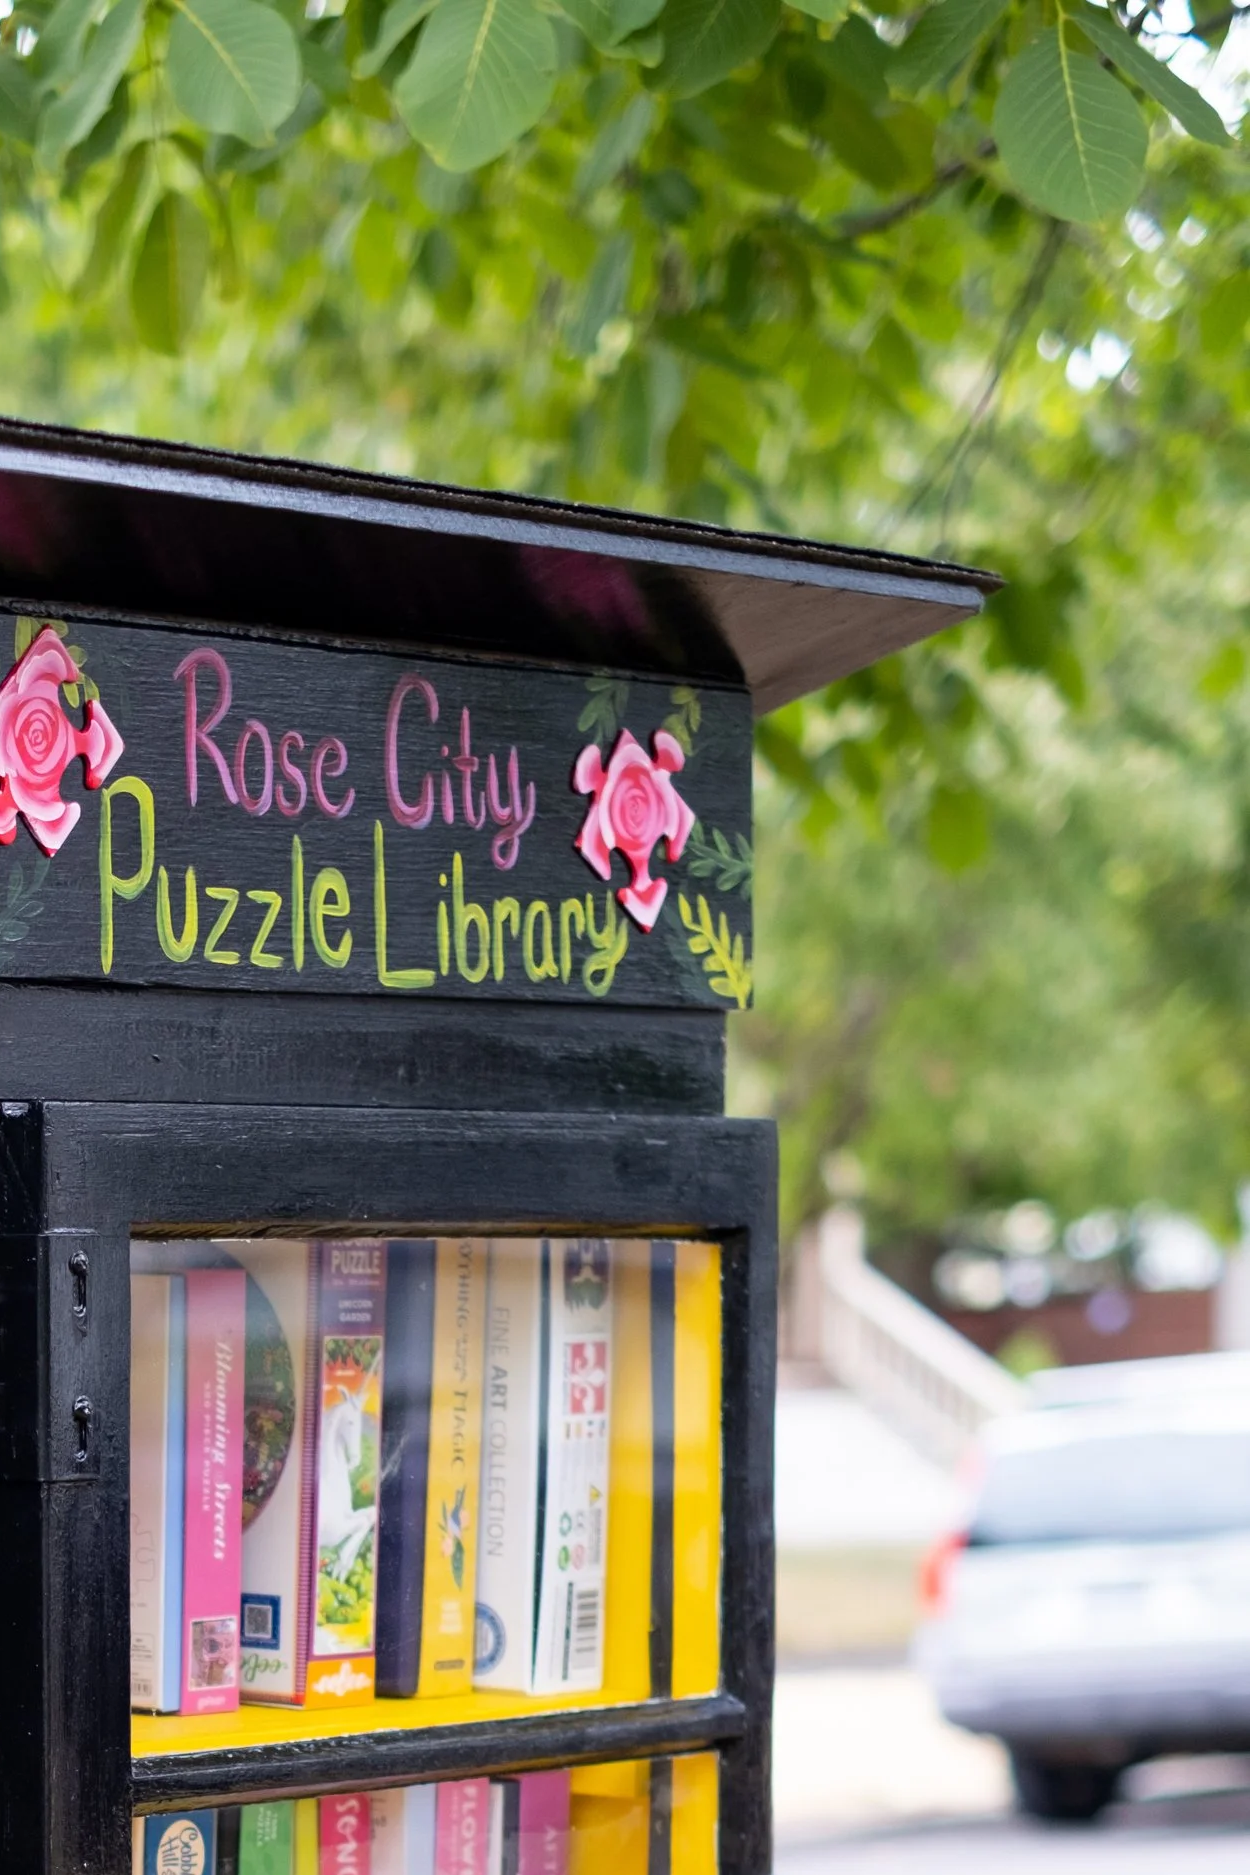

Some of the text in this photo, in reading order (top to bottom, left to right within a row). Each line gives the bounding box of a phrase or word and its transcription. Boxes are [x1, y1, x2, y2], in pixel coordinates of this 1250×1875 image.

[174, 648, 536, 870] Rose City
[99, 776, 630, 997] Puzzle Library
[331, 1250, 381, 1275] PUZZLE
[211, 1339, 234, 1561] Blooming Streets
[486, 1306, 510, 1557] FINE ART COLLECTION
[161, 1836, 181, 1868] Hill
